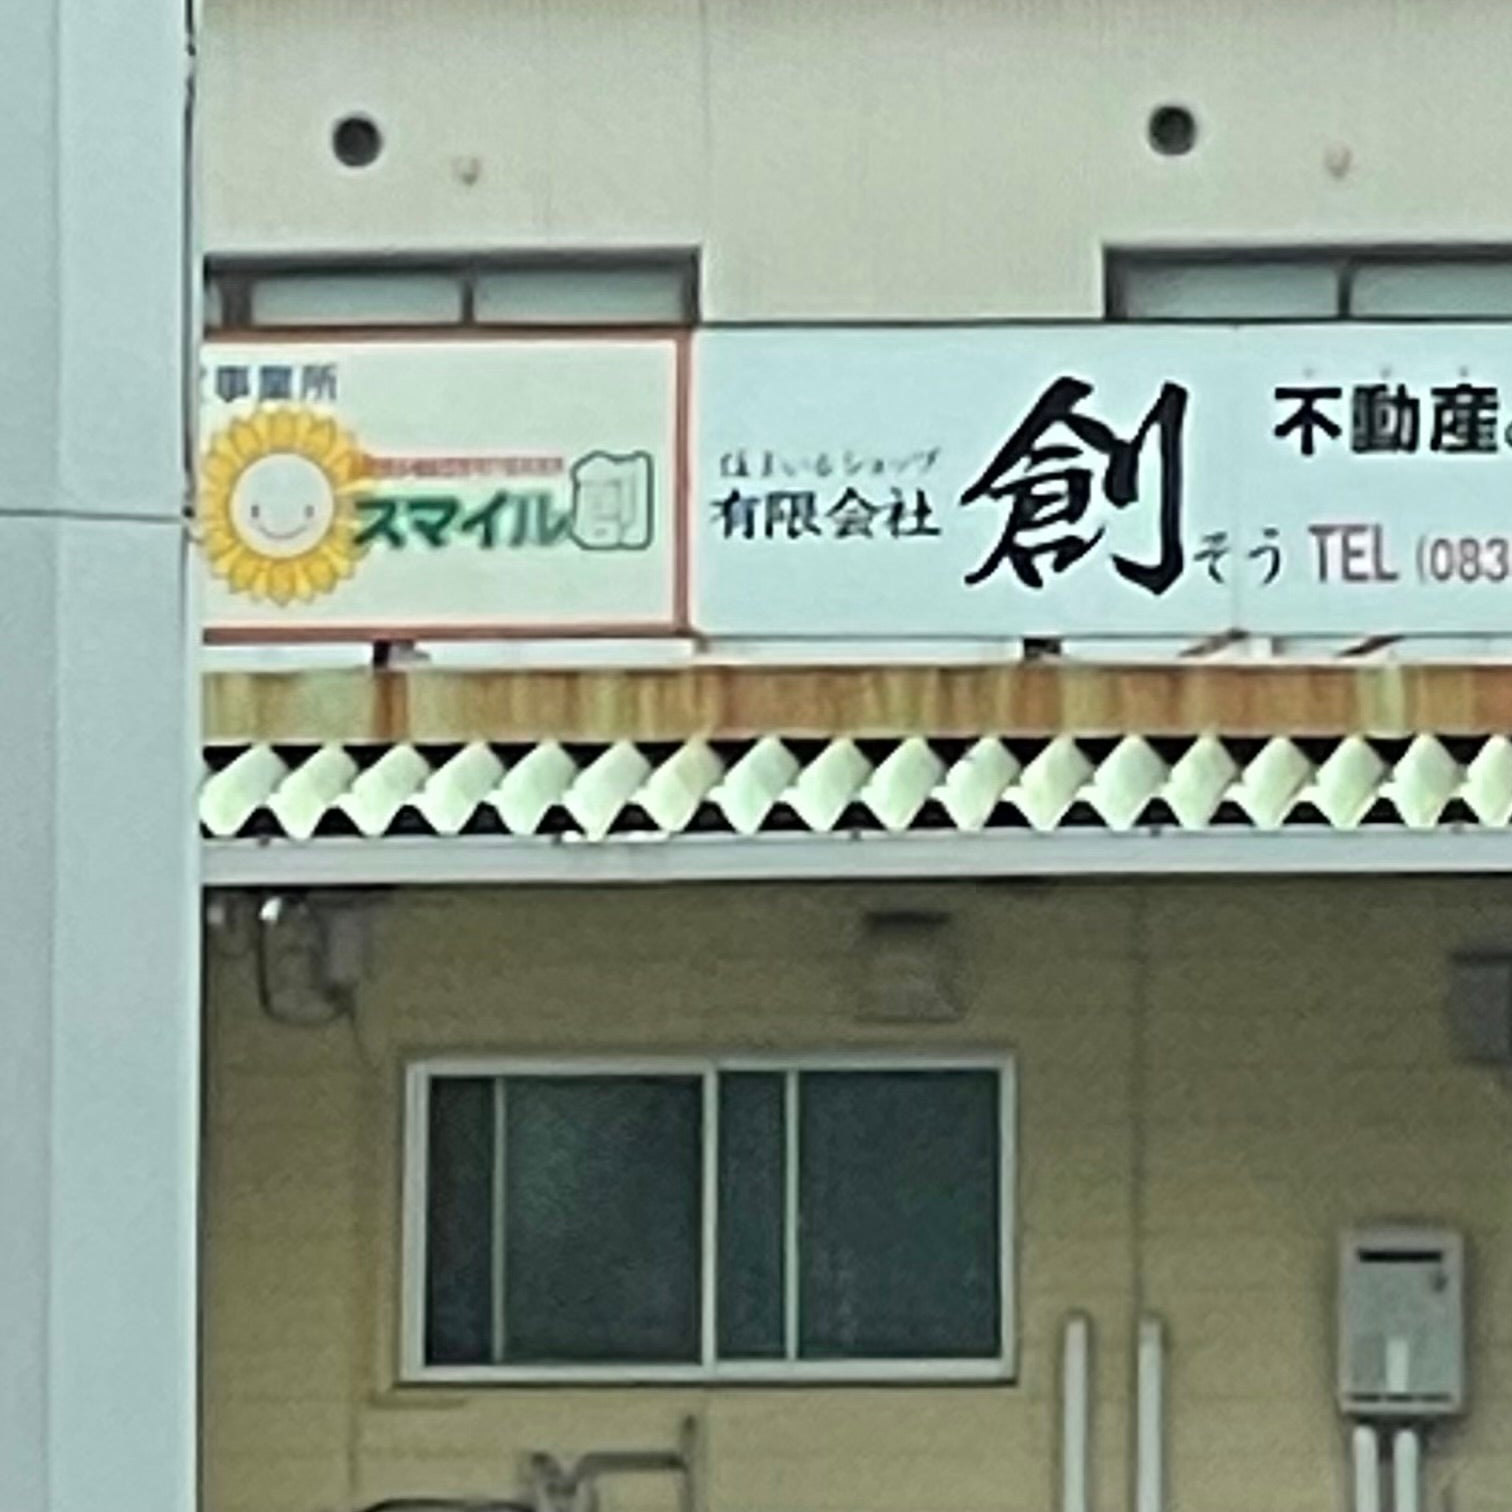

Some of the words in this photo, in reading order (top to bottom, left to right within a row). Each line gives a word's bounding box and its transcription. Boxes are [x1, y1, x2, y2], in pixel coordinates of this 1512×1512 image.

[199, 363, 337, 403] 事業所
[710, 487, 942, 539] 有限会社
[959, 375, 1189, 597] 創
[1308, 522, 1399, 584] TEL
